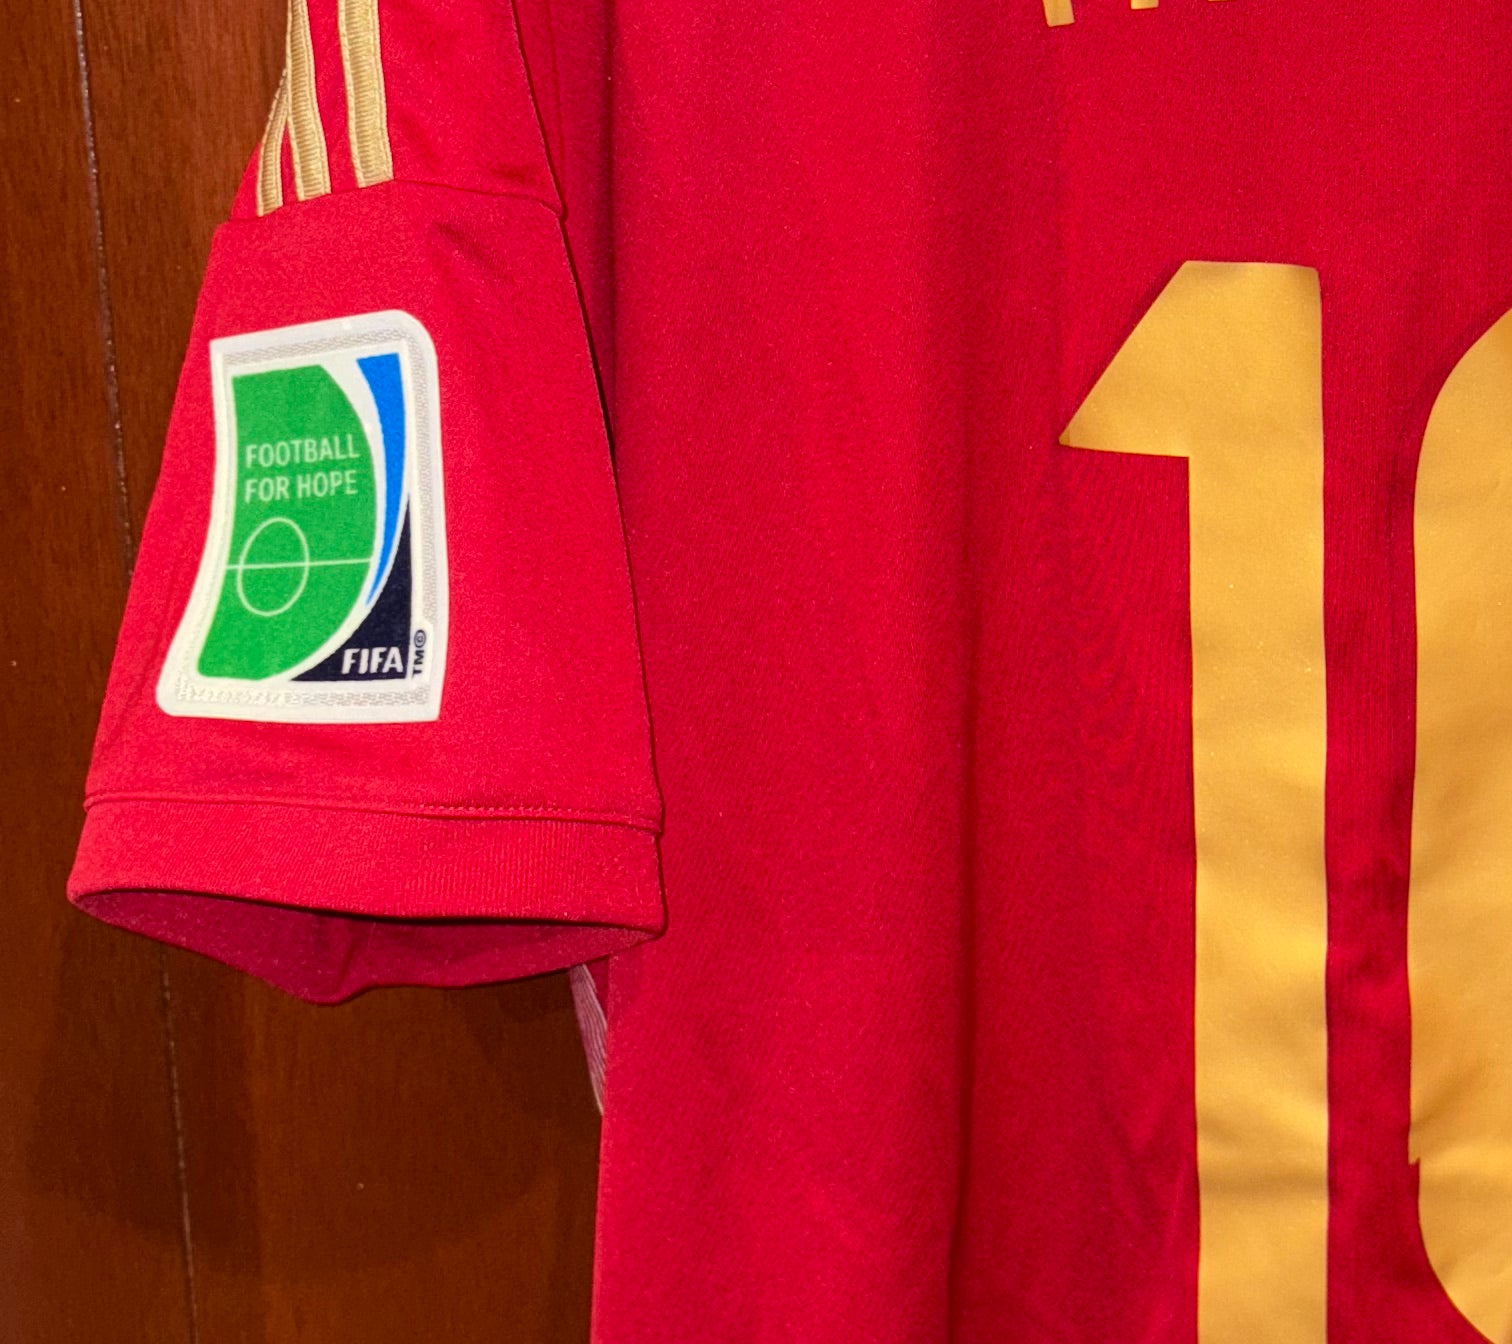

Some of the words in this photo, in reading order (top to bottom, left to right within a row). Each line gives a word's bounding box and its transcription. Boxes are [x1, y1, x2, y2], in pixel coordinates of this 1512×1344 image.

[245, 434, 360, 468] FOOTBALL
[245, 475, 290, 504] FOR
[297, 469, 358, 498] HOPE
[341, 646, 404, 674] FIFA
